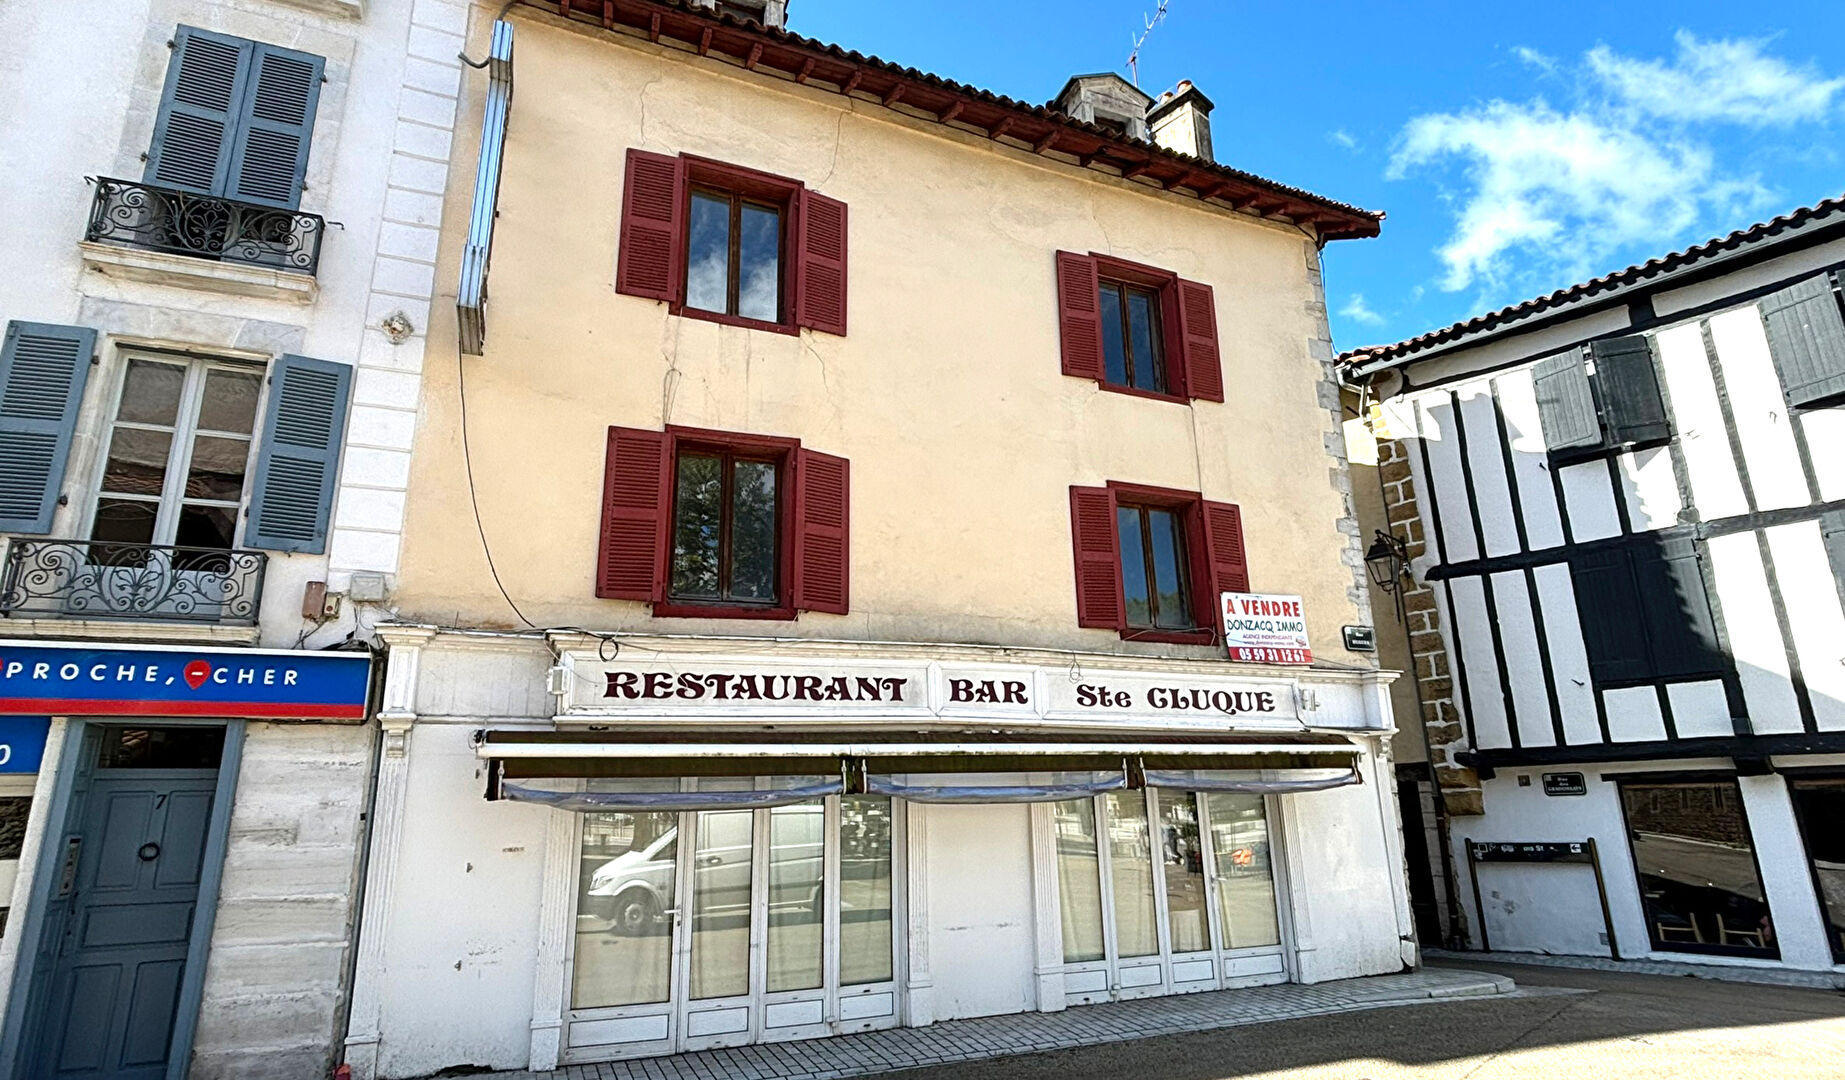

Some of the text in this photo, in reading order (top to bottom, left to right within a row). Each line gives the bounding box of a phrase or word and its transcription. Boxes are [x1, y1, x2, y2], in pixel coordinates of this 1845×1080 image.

[1226, 599, 1300, 617] A VENDRE
[1226, 619, 1303, 633] DONZACQ IMMO
[1238, 648, 1252, 660] 05
[1253, 648, 1265, 661] 59
[1266, 649, 1279, 661] 31
[1280, 649, 1293, 662] 12
[6, 662, 175, 686] PROCHE,
[213, 667, 298, 686] CHER
[603, 672, 908, 702] RESTAURANT
[949, 678, 1029, 704] BAR
[1076, 684, 1132, 708] Ste
[155, 794, 167, 810] 7
